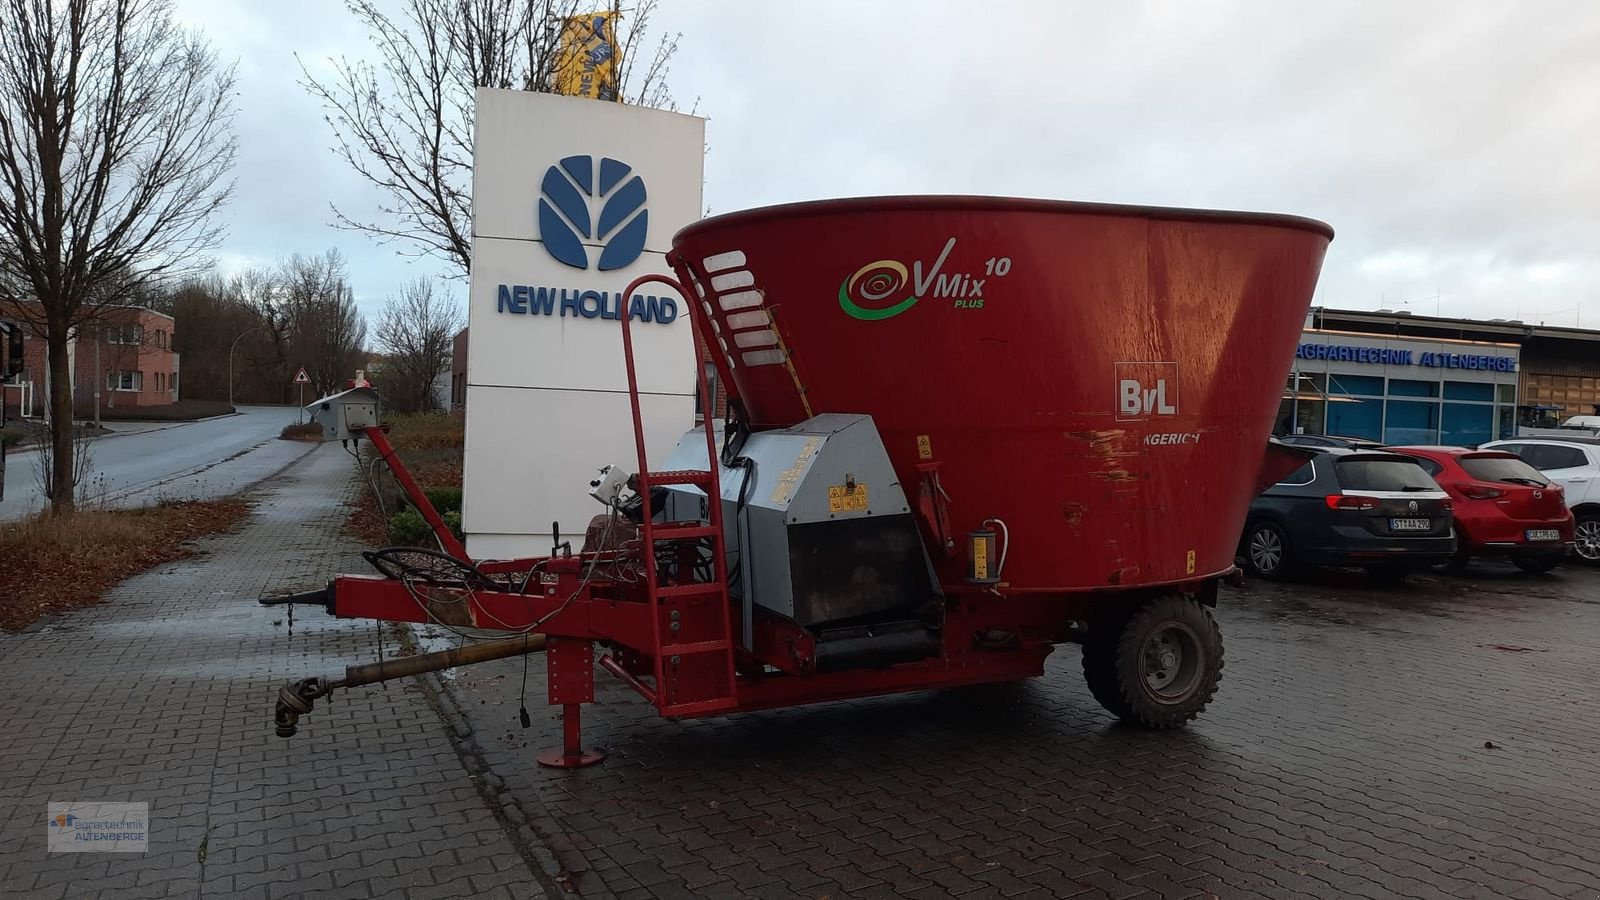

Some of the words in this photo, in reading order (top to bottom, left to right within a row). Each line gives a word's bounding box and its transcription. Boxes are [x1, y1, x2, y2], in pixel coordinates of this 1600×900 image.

[985, 257, 1012, 277] 10
[498, 284, 556, 314] NEW
[560, 288, 677, 324] HOLLAND
[954, 299, 984, 309] PLUS
[1295, 343, 1414, 366] AGRARTECHNIK
[1420, 351, 1516, 372] ALTENBERGE
